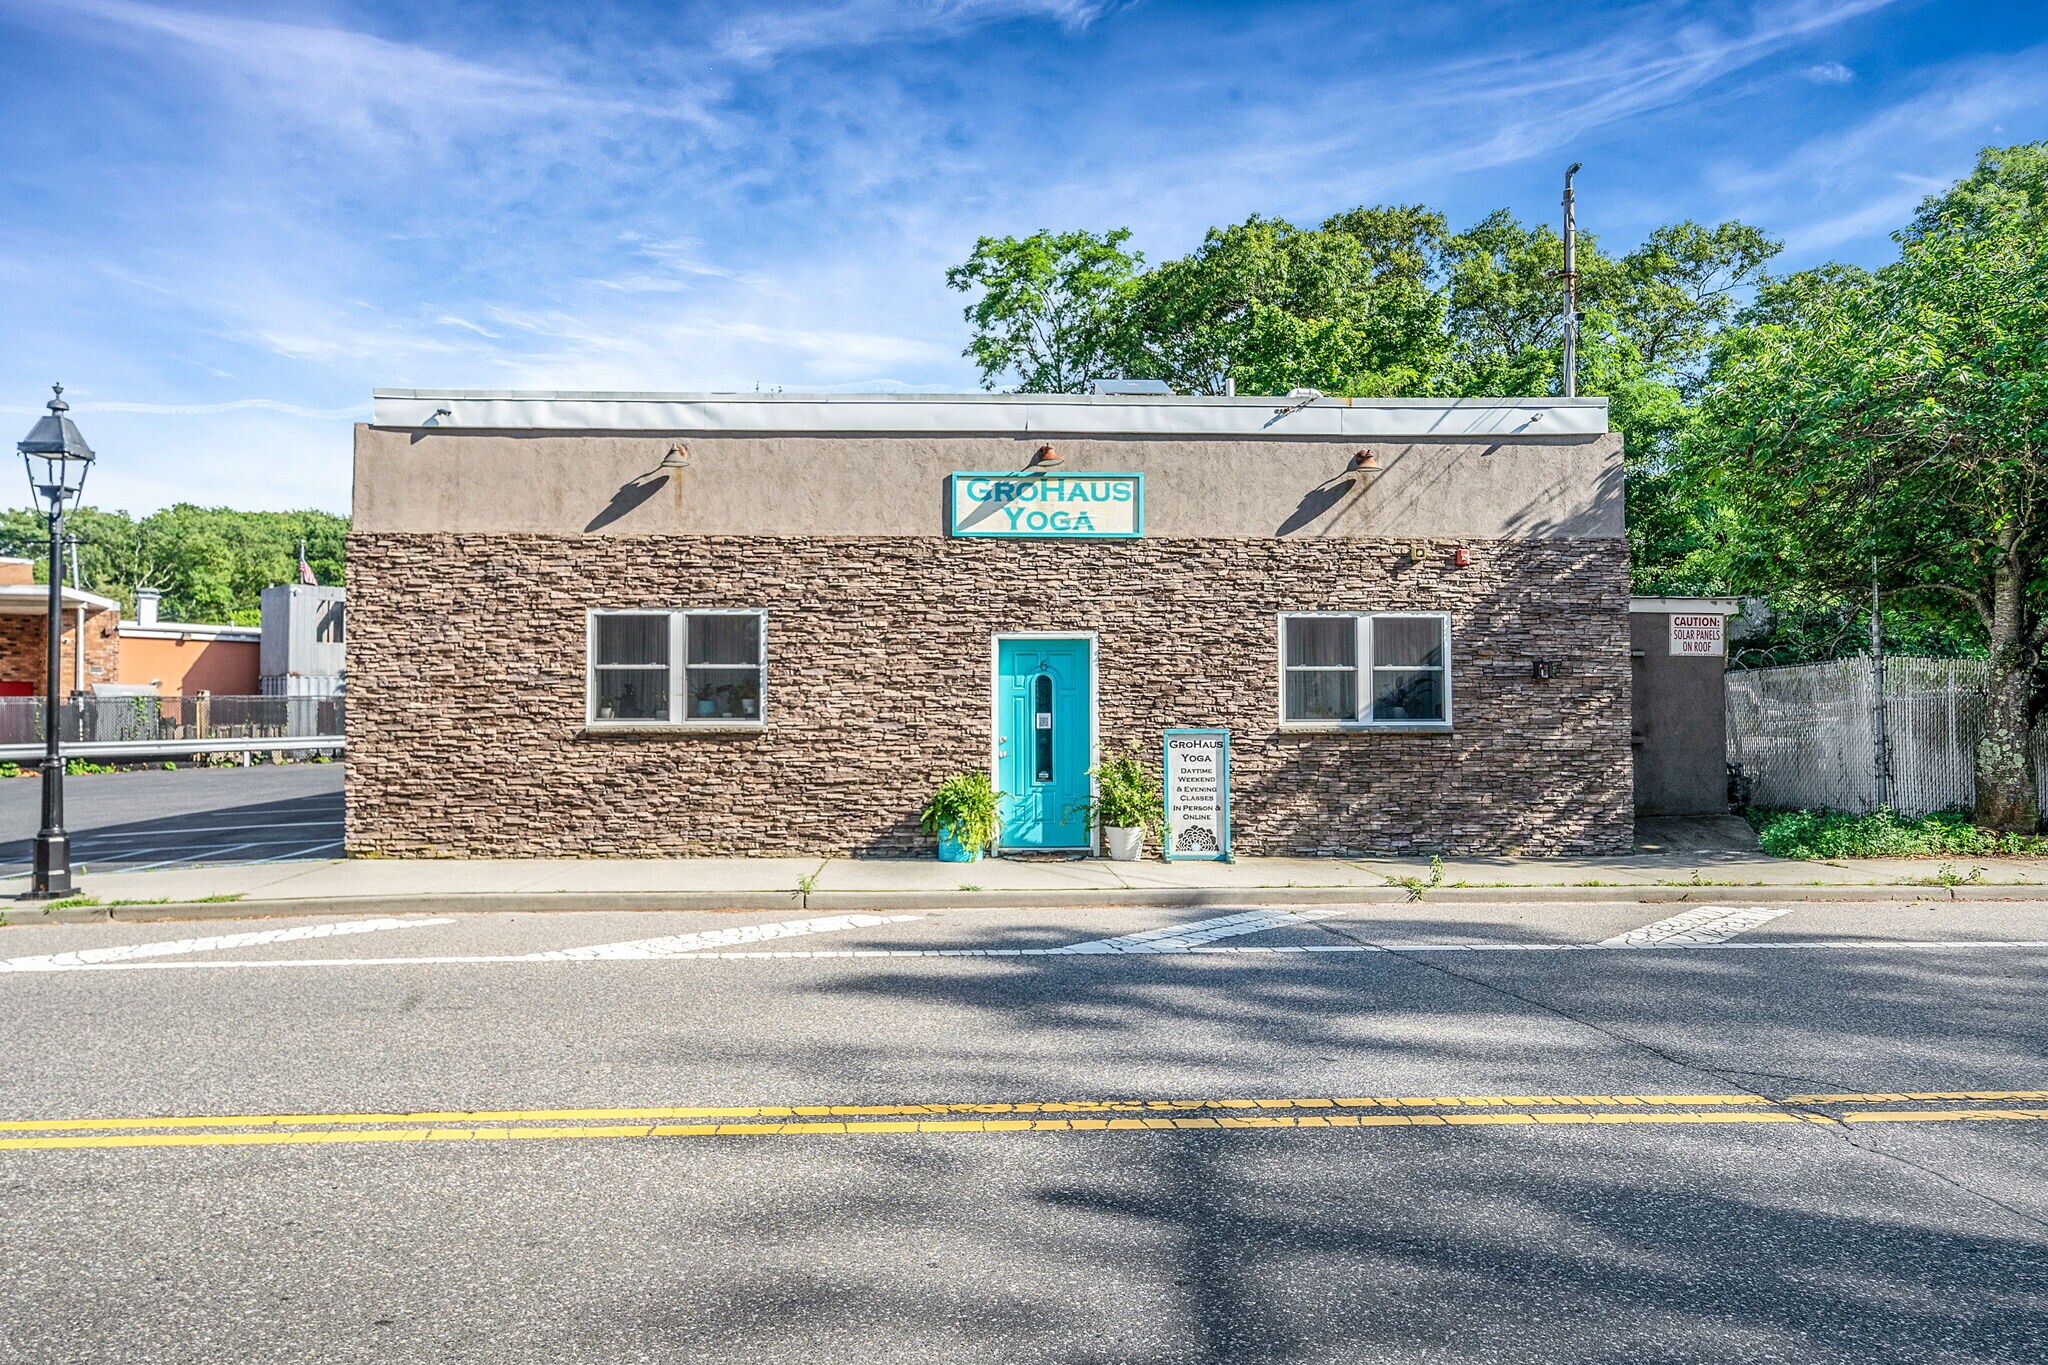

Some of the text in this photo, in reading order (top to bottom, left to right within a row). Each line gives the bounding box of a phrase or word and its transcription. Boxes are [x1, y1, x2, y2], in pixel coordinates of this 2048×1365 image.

[1003, 507, 1095, 531] YOGA
[1674, 617, 1720, 627] CAUTION:
[1673, 630, 1720, 640] SOLAR PANELS
[1683, 642, 1712, 652] ON ROOF
[1040, 660, 1048, 671] 6
[1181, 753, 1212, 762] YOGA
